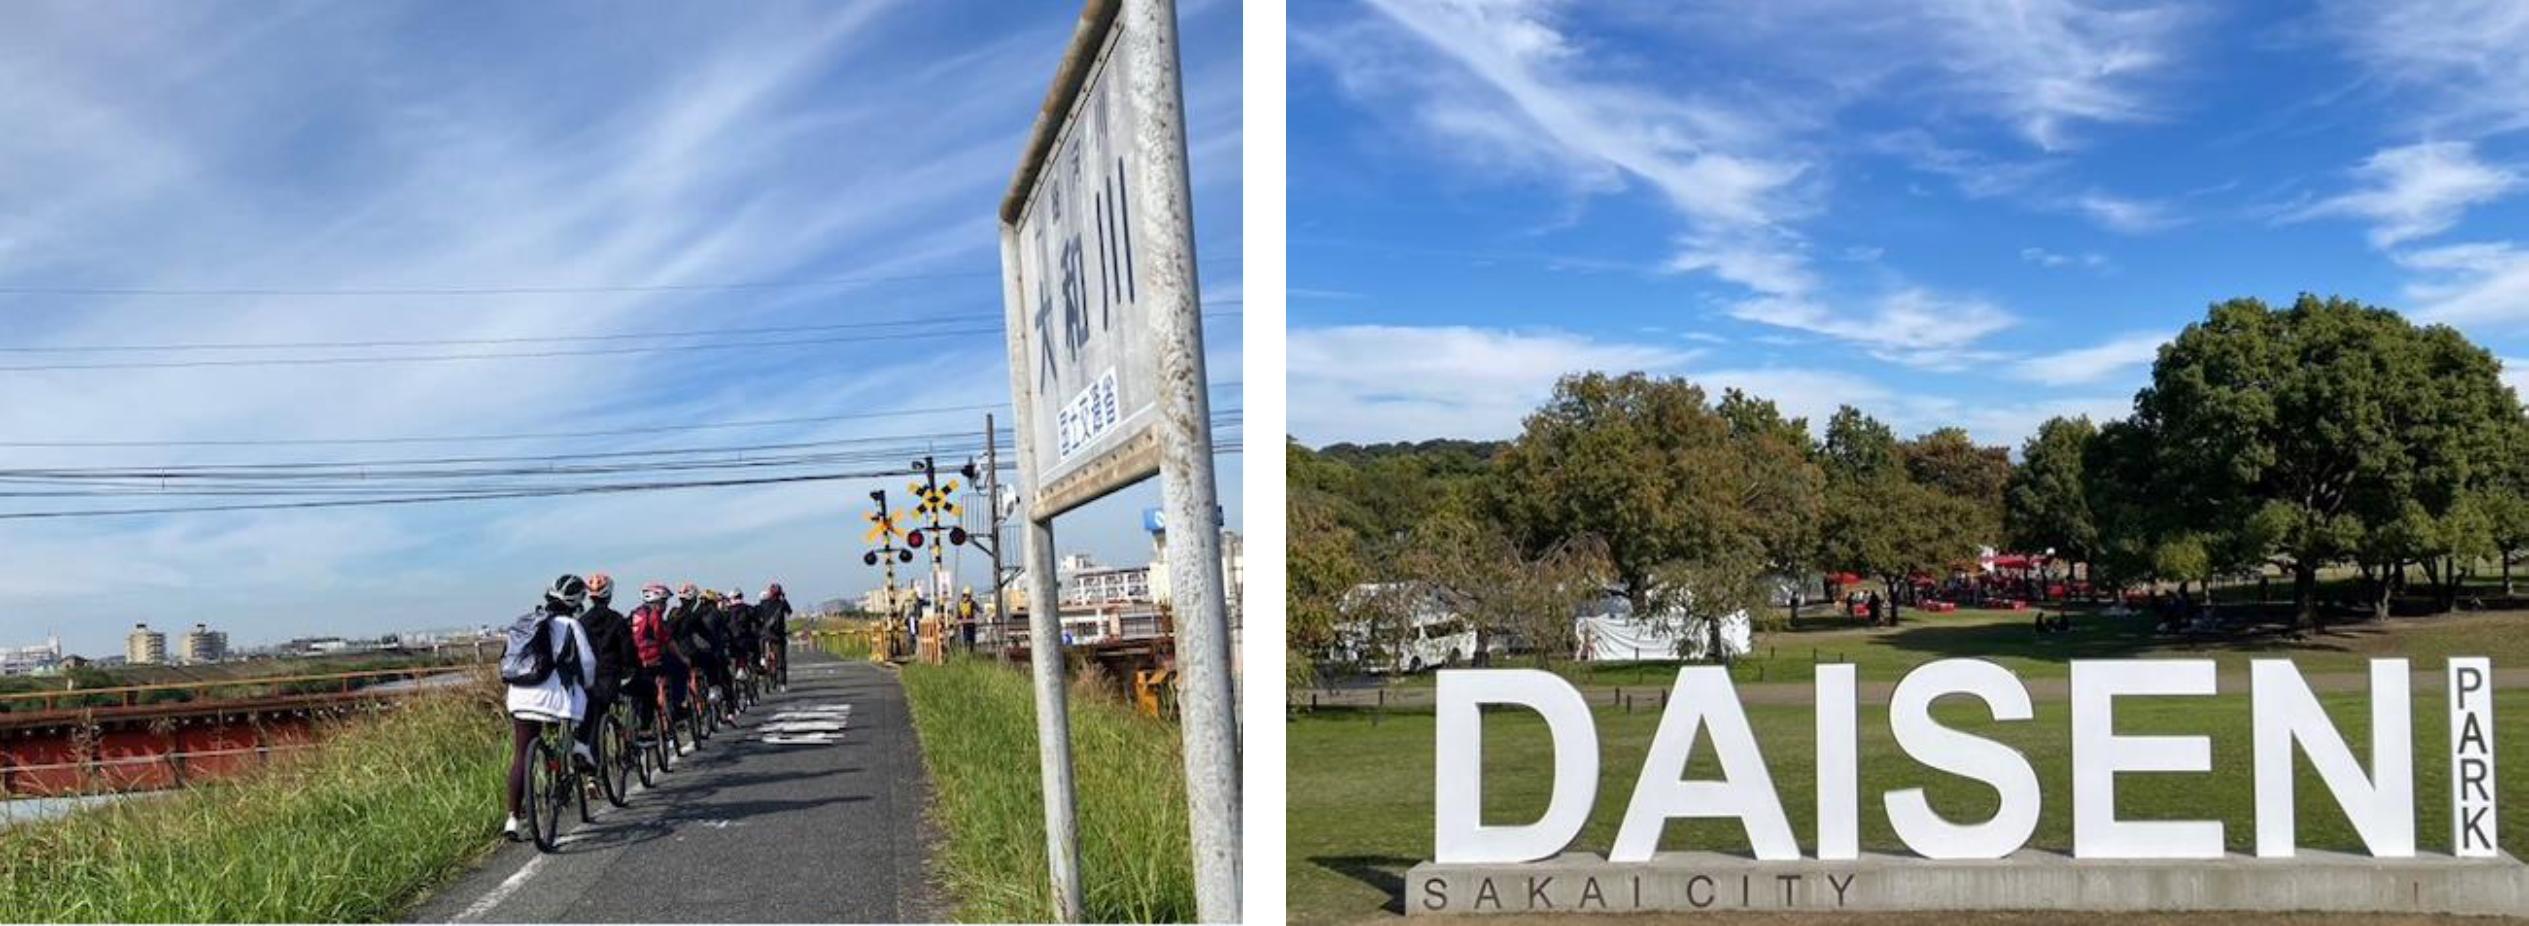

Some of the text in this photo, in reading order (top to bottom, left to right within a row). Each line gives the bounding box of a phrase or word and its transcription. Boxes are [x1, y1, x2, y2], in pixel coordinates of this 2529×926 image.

[1034, 156, 1135, 395] 大和川
[1060, 374, 1115, 456] 国土交通省
[1435, 658, 2415, 863] DAISEN
[2456, 667, 2491, 851] PARK
[1423, 873, 1857, 911] SAKAI CITY
